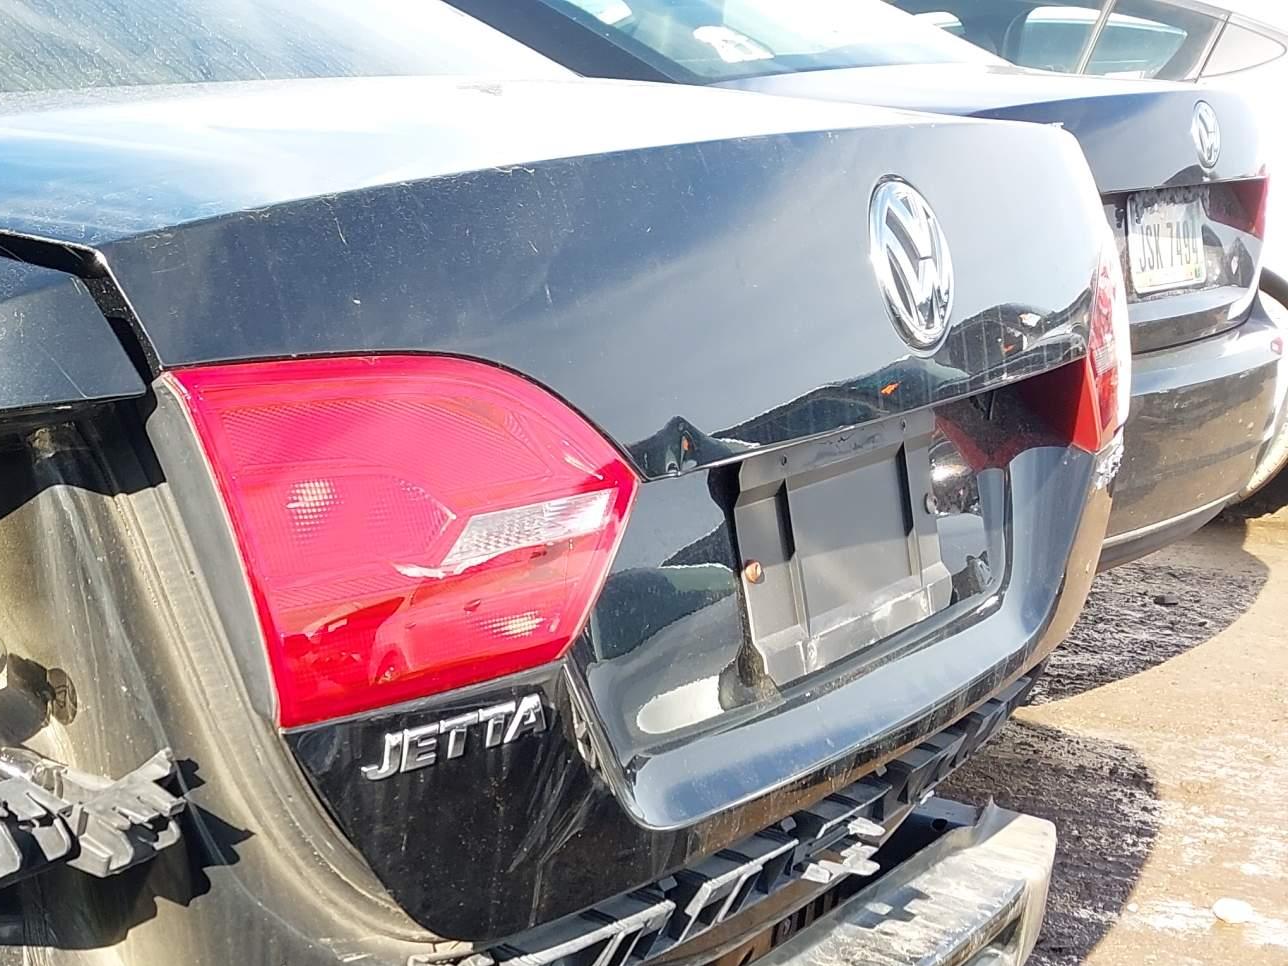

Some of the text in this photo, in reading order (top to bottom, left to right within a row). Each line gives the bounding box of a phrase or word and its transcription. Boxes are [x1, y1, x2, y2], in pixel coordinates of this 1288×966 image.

[1139, 218, 1199, 273] JSK 7494
[360, 693, 547, 781] JETTA
